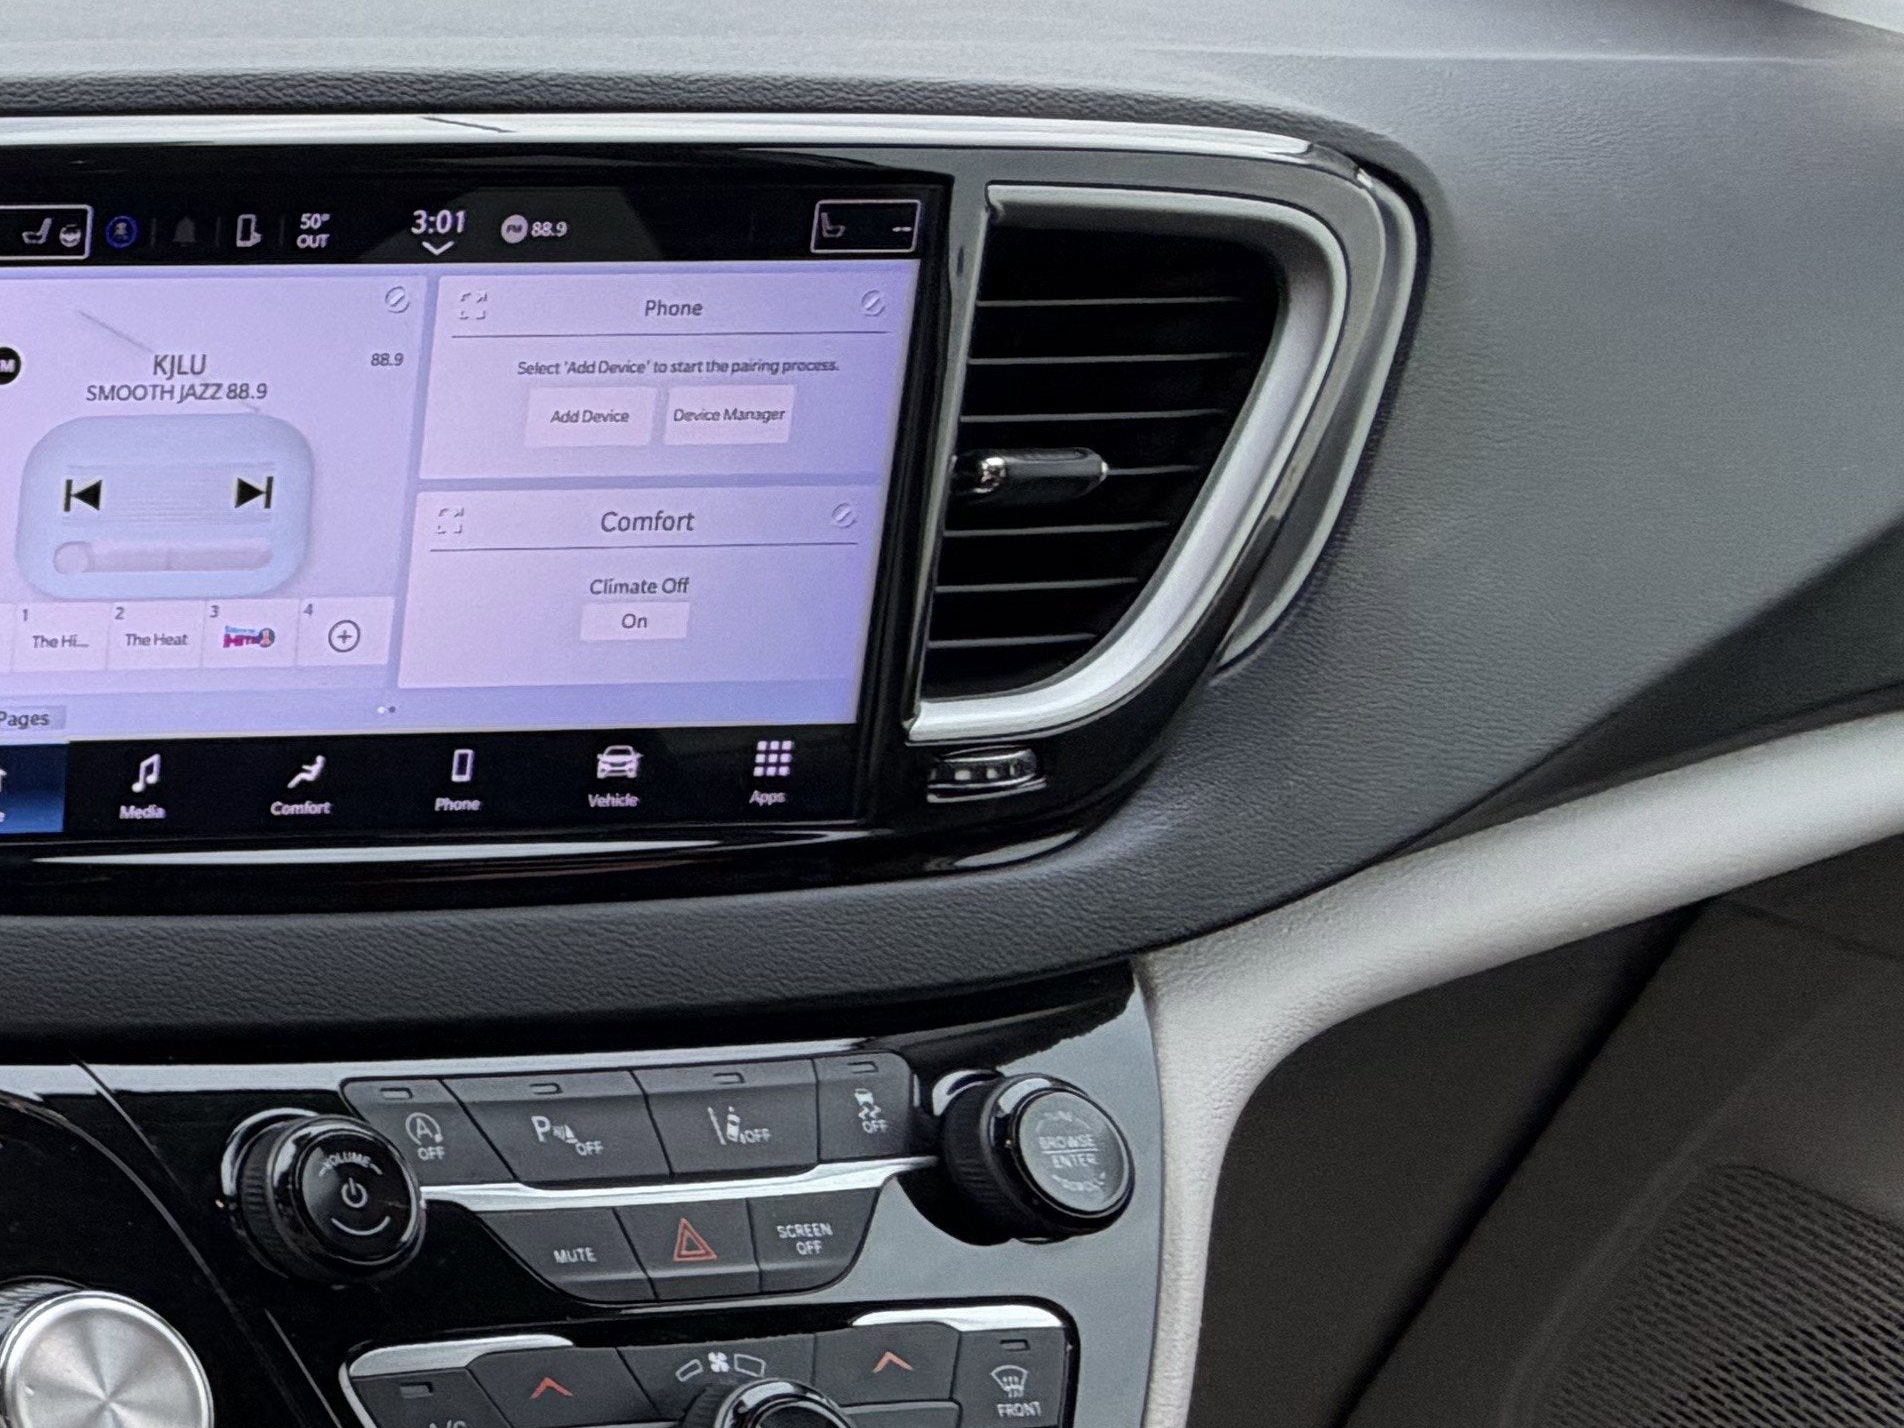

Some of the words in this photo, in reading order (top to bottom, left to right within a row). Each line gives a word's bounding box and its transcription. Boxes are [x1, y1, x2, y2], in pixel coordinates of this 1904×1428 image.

[410, 209, 466, 235] 3:01
[531, 221, 568, 238] 88.9
[296, 233, 330, 249] OUT
[644, 299, 703, 317] Phone
[153, 353, 208, 381] KJLU
[370, 352, 405, 367] 88.9
[517, 361, 560, 376] Select
[653, 361, 668, 374] to
[670, 361, 704, 374] start
[706, 360, 729, 373] the
[731, 359, 779, 376] pairing
[781, 360, 840, 375] process.
[85, 384, 174, 402] SMOOTH
[175, 383, 223, 404] JAZZ
[226, 382, 268, 400] 88.9
[550, 409, 579, 423] Add
[582, 409, 630, 423] Device
[673, 408, 721, 423] Device
[723, 408, 786, 424] Manager
[600, 509, 695, 533] Comfort
[589, 578, 658, 595] Climate
[661, 576, 690, 594] Off
[114, 607, 126, 621] 2
[209, 604, 219, 618] 3
[303, 603, 313, 616] 4
[621, 613, 648, 629] On
[32, 634, 58, 648] The
[125, 633, 151, 647] The
[153, 633, 188, 647] Heat
[434, 797, 481, 812] Phone
[588, 792, 639, 808] Vehicle
[749, 790, 786, 806] Apps
[119, 804, 167, 820] Media
[270, 800, 331, 817] Comfort
[861, 1118, 889, 1135] OFF
[746, 1127, 772, 1144] OFF
[1038, 1134, 1097, 1149] BROWSE
[417, 1146, 445, 1162] OFF
[575, 1141, 604, 1156] OFF
[323, 1151, 372, 1170] VOLUME
[1051, 1153, 1101, 1169] ENTER
[775, 1222, 834, 1239] SCREEN
[553, 1247, 598, 1264] MUTE
[795, 1240, 823, 1256] OFF
[996, 1400, 1043, 1419] FRONT
